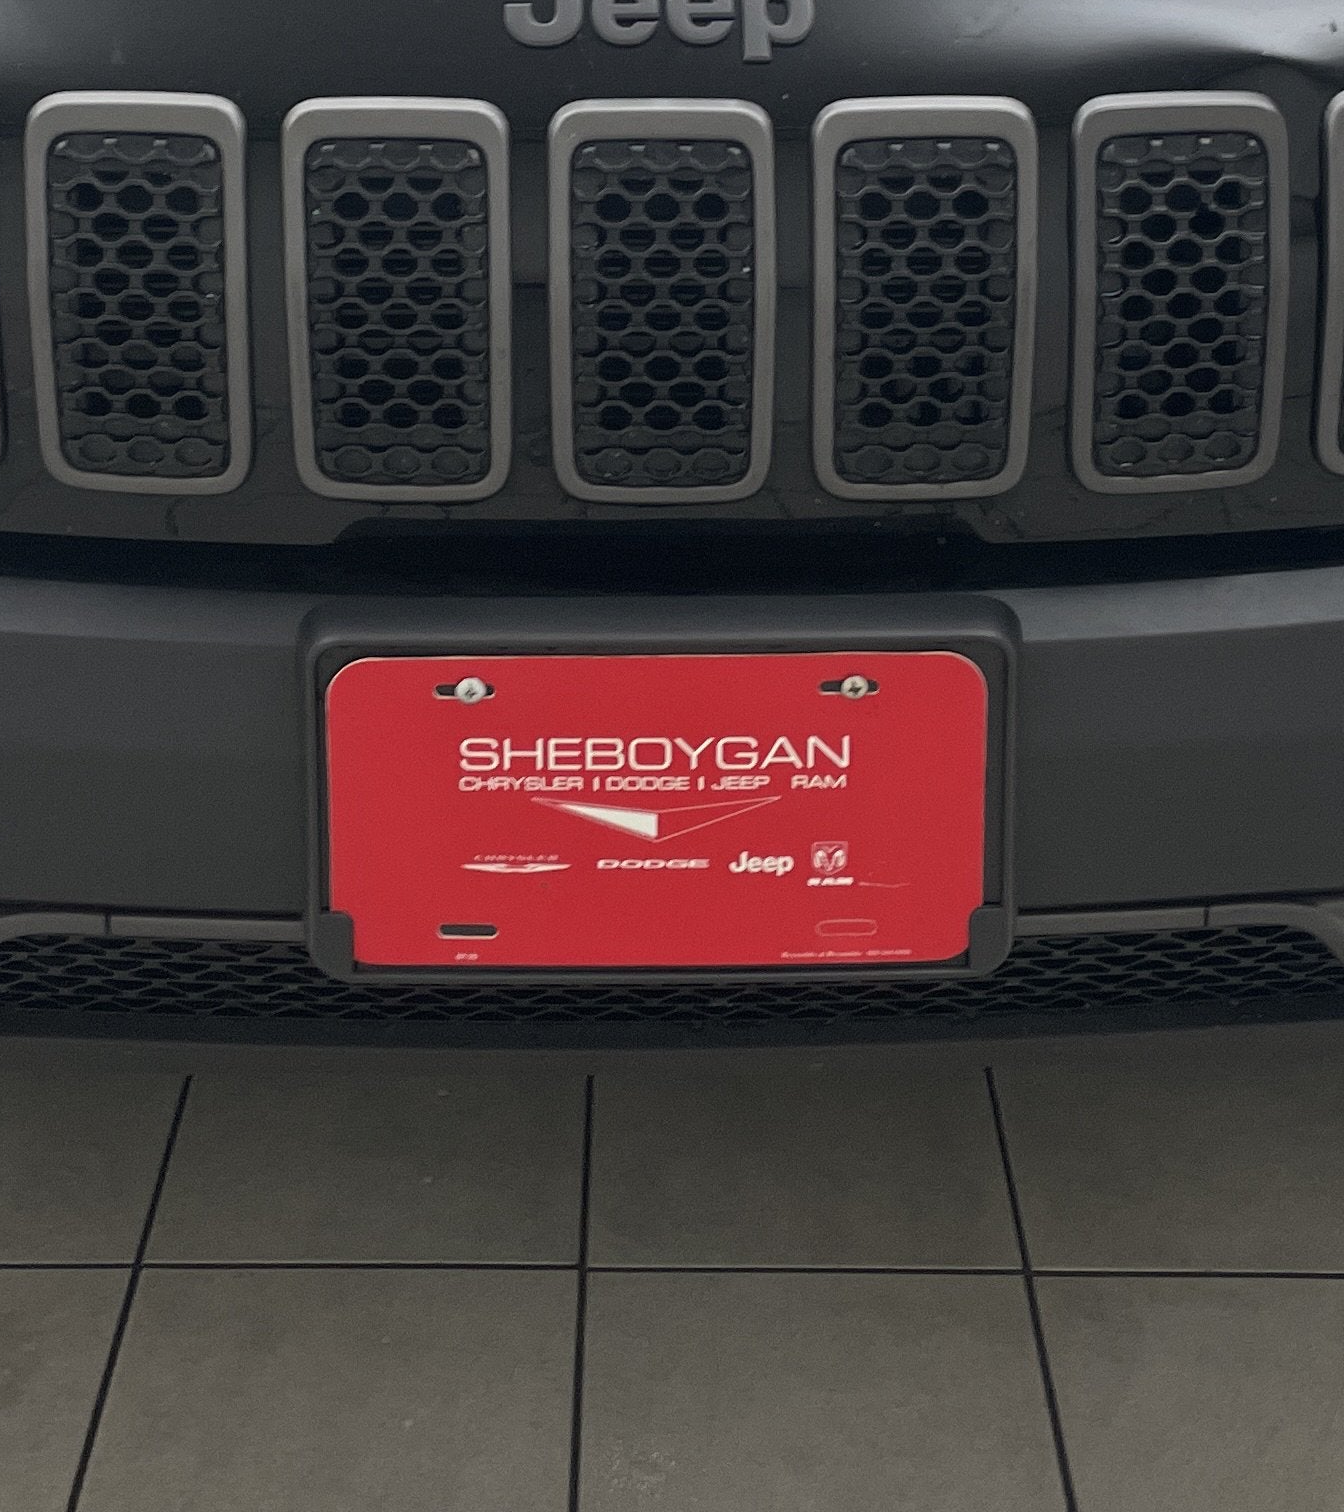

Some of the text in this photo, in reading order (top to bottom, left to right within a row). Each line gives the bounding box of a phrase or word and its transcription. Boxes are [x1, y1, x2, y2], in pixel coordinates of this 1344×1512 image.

[458, 735, 851, 772] SHEBOYGAN
[458, 774, 848, 792] CHRYSLER DODGE JEEP RAM
[596, 859, 710, 870] DODGE
[728, 850, 795, 877] Jeep
